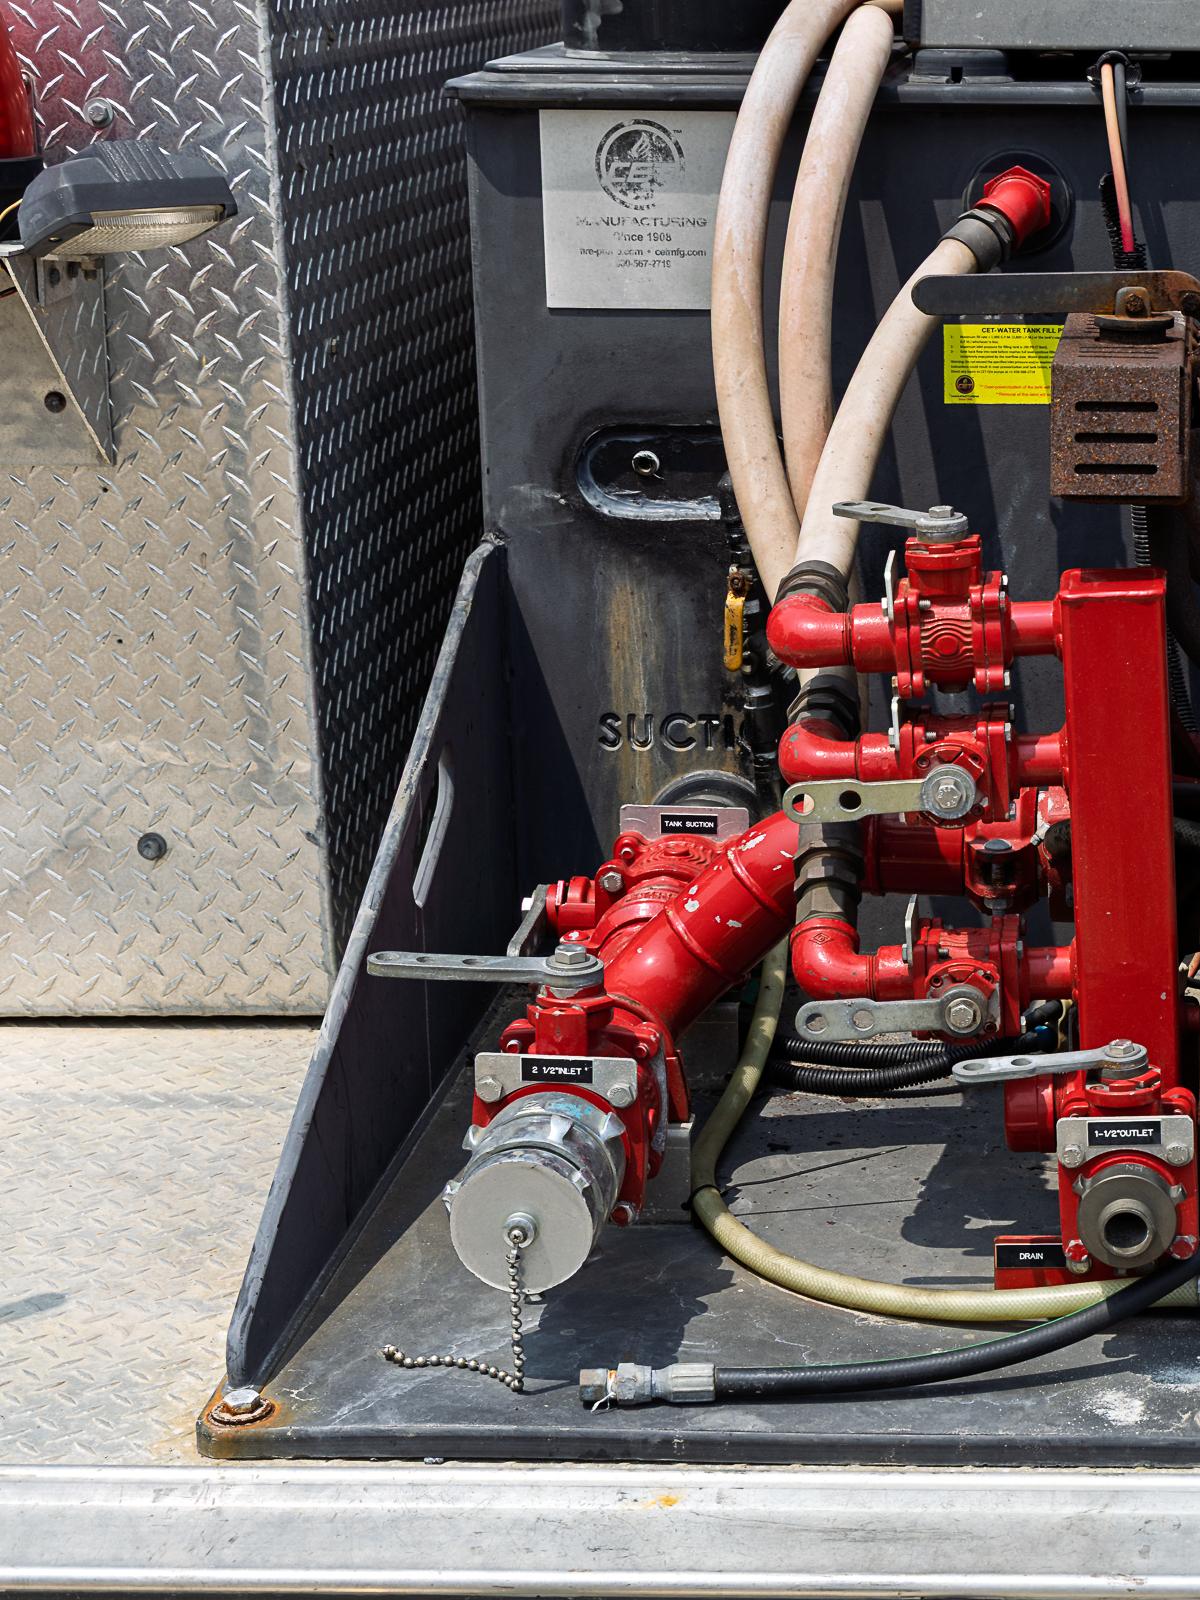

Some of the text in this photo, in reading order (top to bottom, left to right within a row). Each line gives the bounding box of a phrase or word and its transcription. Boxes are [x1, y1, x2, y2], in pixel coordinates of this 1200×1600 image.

[598, 712, 754, 751] SUCTI
[532, 1066, 538, 1074] 2
[1019, 1252, 1044, 1260] DRAIN
